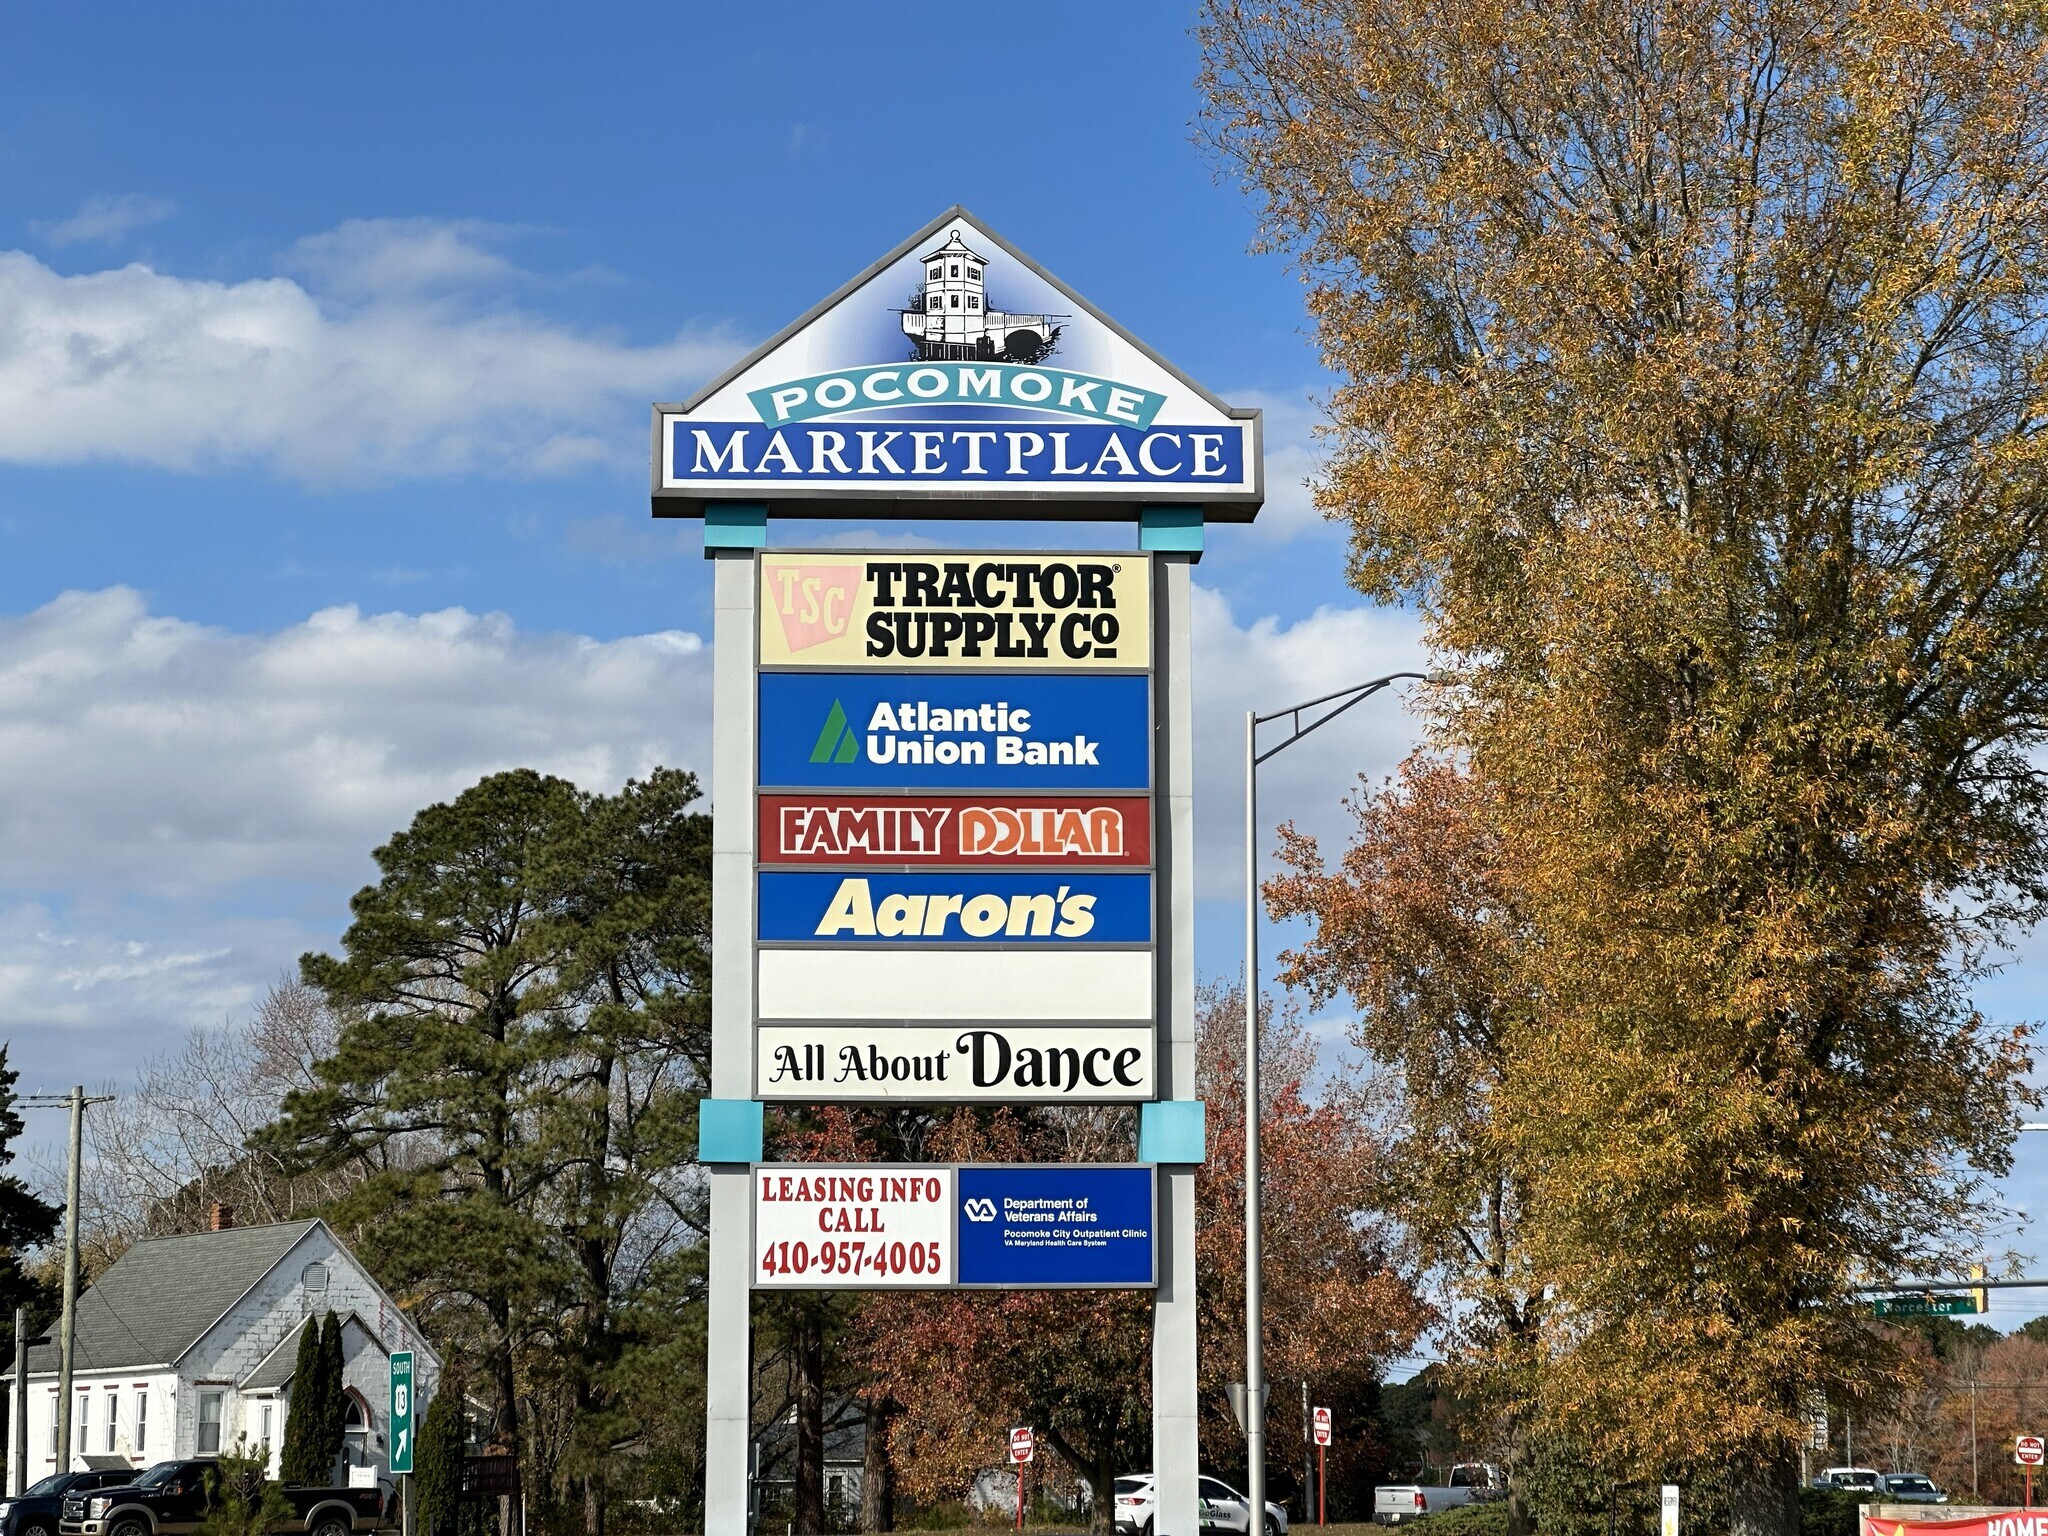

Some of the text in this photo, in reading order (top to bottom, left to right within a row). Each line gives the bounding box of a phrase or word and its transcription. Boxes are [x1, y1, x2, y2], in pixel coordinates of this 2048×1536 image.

[769, 366, 1148, 424] POCOMOKE
[690, 428, 1228, 477] MARKETPLACE
[777, 568, 846, 635] TSC
[866, 611, 1056, 658] SUPPLY
[867, 701, 1032, 733] Atlantic
[866, 735, 1099, 766] Union Bank
[779, 806, 1124, 856] FAMILY DOLLAR
[814, 878, 1098, 938] Aaron's
[769, 1030, 1143, 1093] All About Dance
[762, 1177, 941, 1203] LEASING INFO
[1004, 1198, 1088, 1211] Department of
[818, 1207, 885, 1233] CALL
[1004, 1211, 1098, 1222] Veterans Affairs
[1004, 1229, 1147, 1239] Pocomoke City Outpatient Clinic
[1015, 1240, 1044, 1248] Maryland
[1083, 1240, 1107, 1248] System
[762, 1240, 941, 1278] 410-957-4005
[393, 1361, 410, 1375] SOUTH
[397, 1391, 406, 1409] 13
